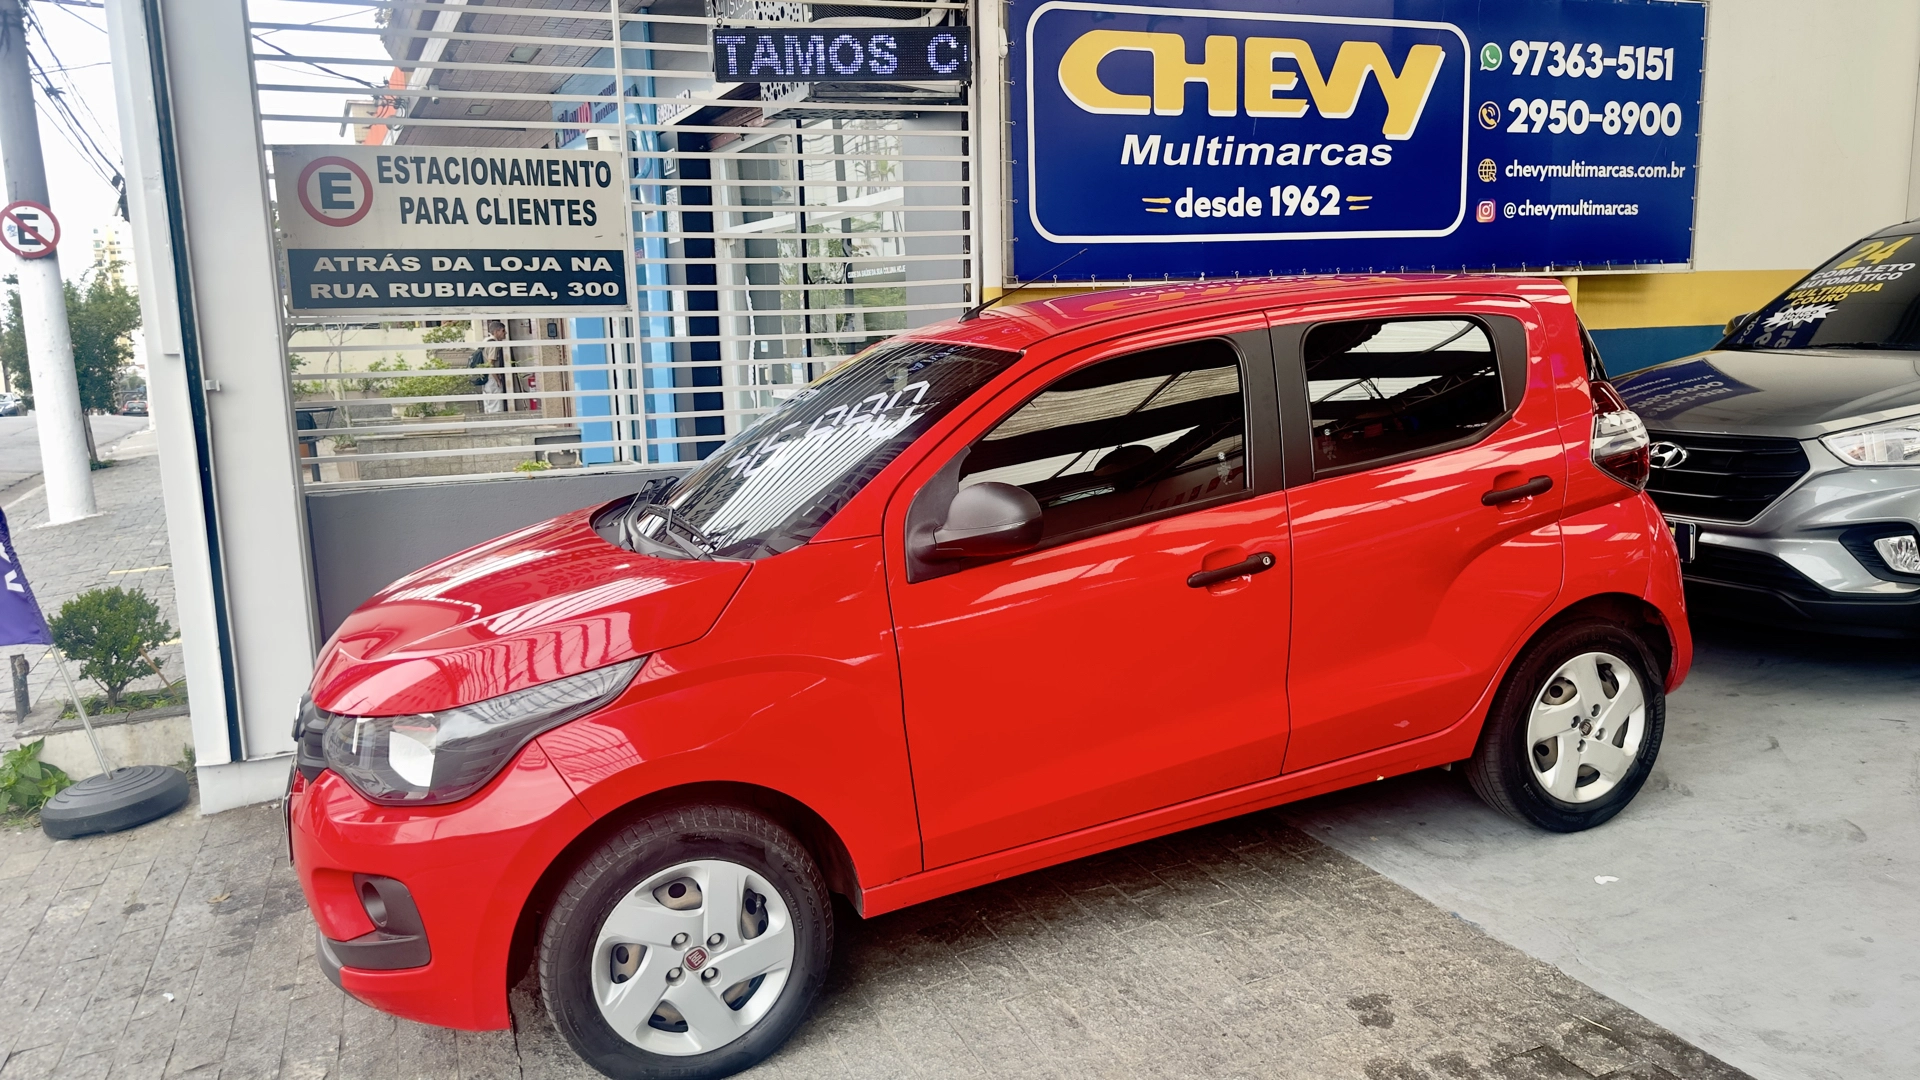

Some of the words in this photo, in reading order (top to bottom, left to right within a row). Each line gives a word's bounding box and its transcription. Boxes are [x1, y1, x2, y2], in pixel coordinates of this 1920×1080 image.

[716, 34, 898, 75] TAMOS
[927, 33, 968, 74] C
[1509, 40, 1674, 81] 97363-5151
[1058, 29, 1446, 141] CHEVY
[1506, 98, 1682, 137] 2950-8900
[1120, 134, 1393, 166] Multimarcas
[376, 155, 612, 188] ESTACIONAMENTO
[1505, 159, 1686, 182] chevymultimarcas.com.br
[319, 172, 355, 210] E
[1175, 187, 1262, 218] desde
[1270, 185, 1341, 216] 1962
[400, 197, 469, 225] PARA
[476, 198, 598, 227] CLIENTES
[1503, 200, 1639, 220] @chevymultimarcas
[16, 213, 41, 245] E
[313, 253, 422, 272] ATRÁS
[432, 256, 474, 272] DA
[483, 256, 562, 273] LOJA
[571, 257, 613, 272] NA
[1834, 236, 1914, 270] 24
[1795, 271, 1904, 290] AUTOMÁTICO
[1810, 262, 1916, 280] COMPLETO
[310, 283, 379, 299] RUA
[389, 282, 558, 300] RUBIACEA,
[567, 282, 619, 298] 300
[1784, 282, 1884, 301] MULTIMÍDIA
[1790, 293, 1849, 307] COURO
